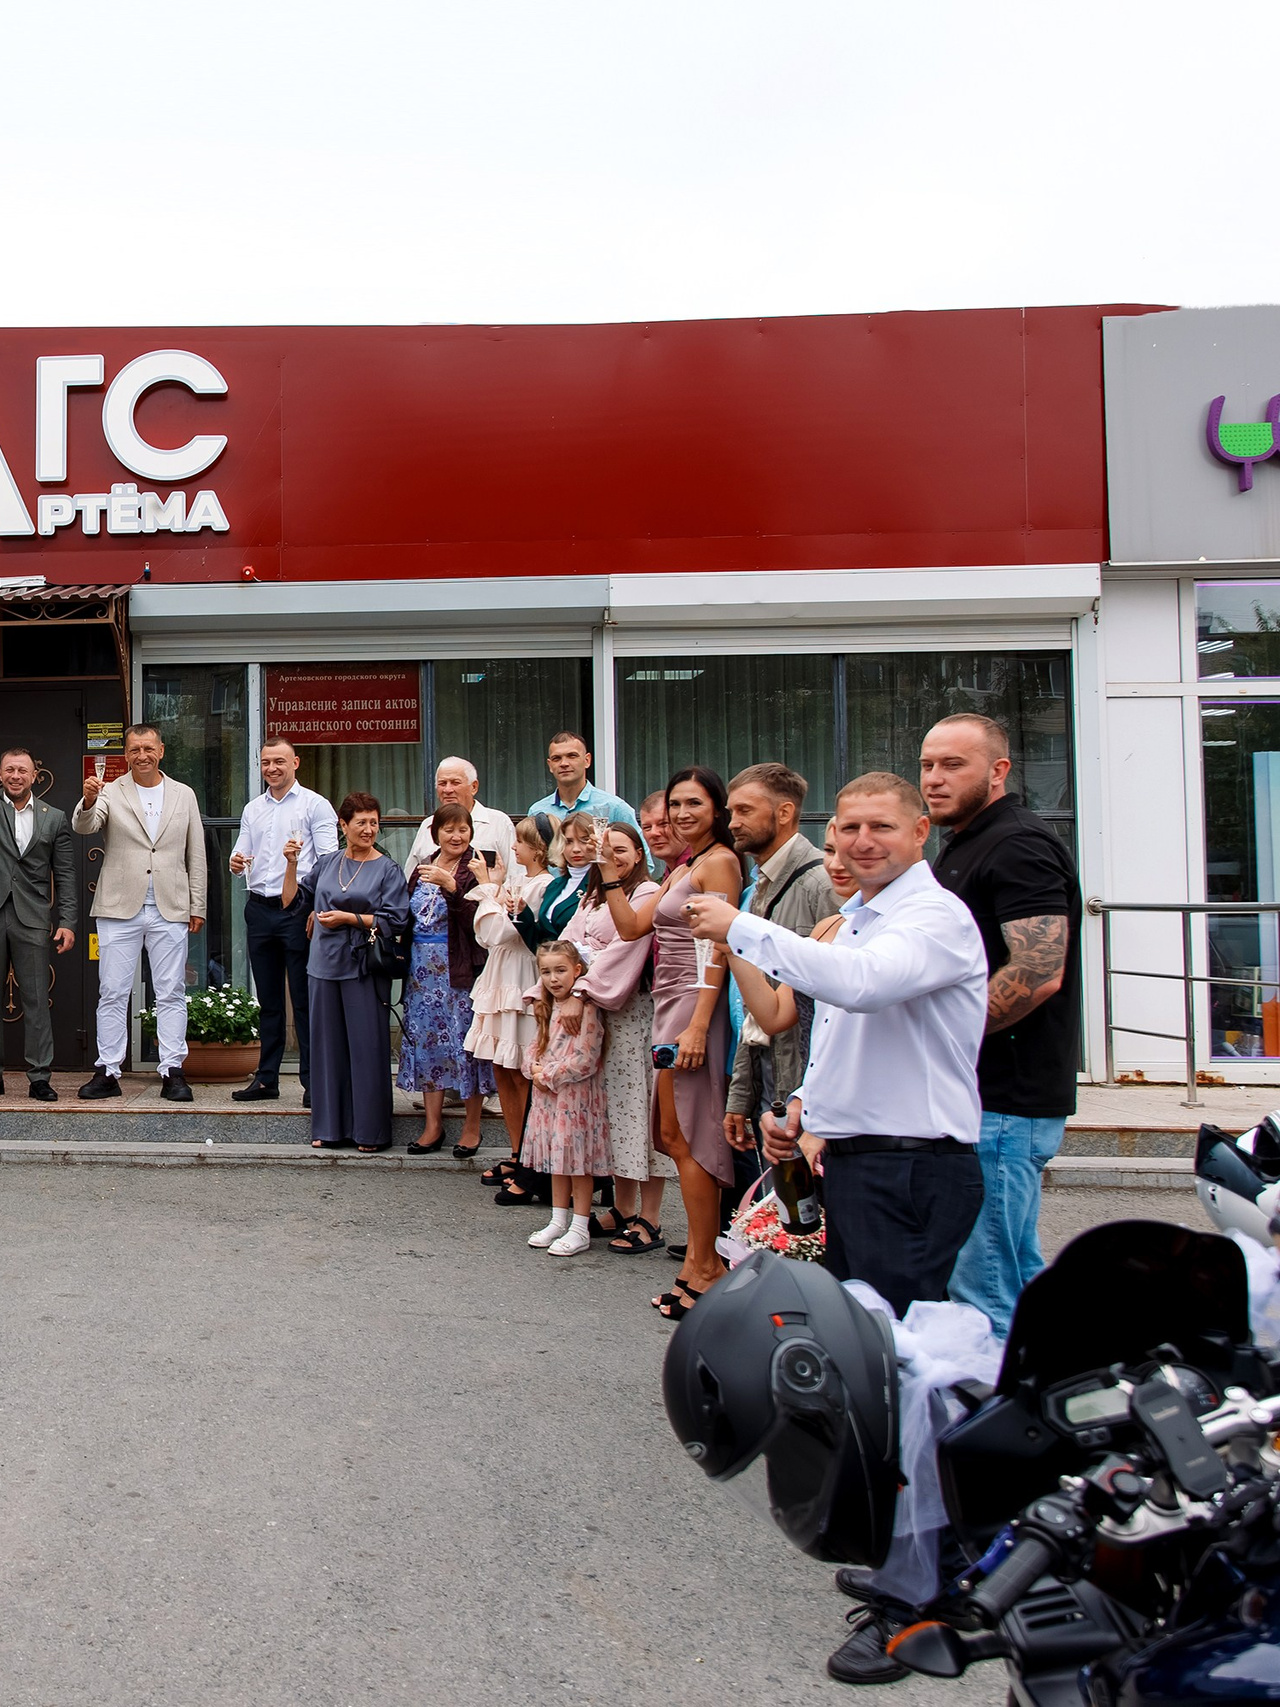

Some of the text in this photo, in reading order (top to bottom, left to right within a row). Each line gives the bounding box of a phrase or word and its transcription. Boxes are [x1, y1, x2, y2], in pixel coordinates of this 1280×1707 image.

[279, 673, 406, 683] Артемовского городского округа
[269, 697, 418, 715] Управление записи актов
[269, 718, 418, 735] гражданского состояния
